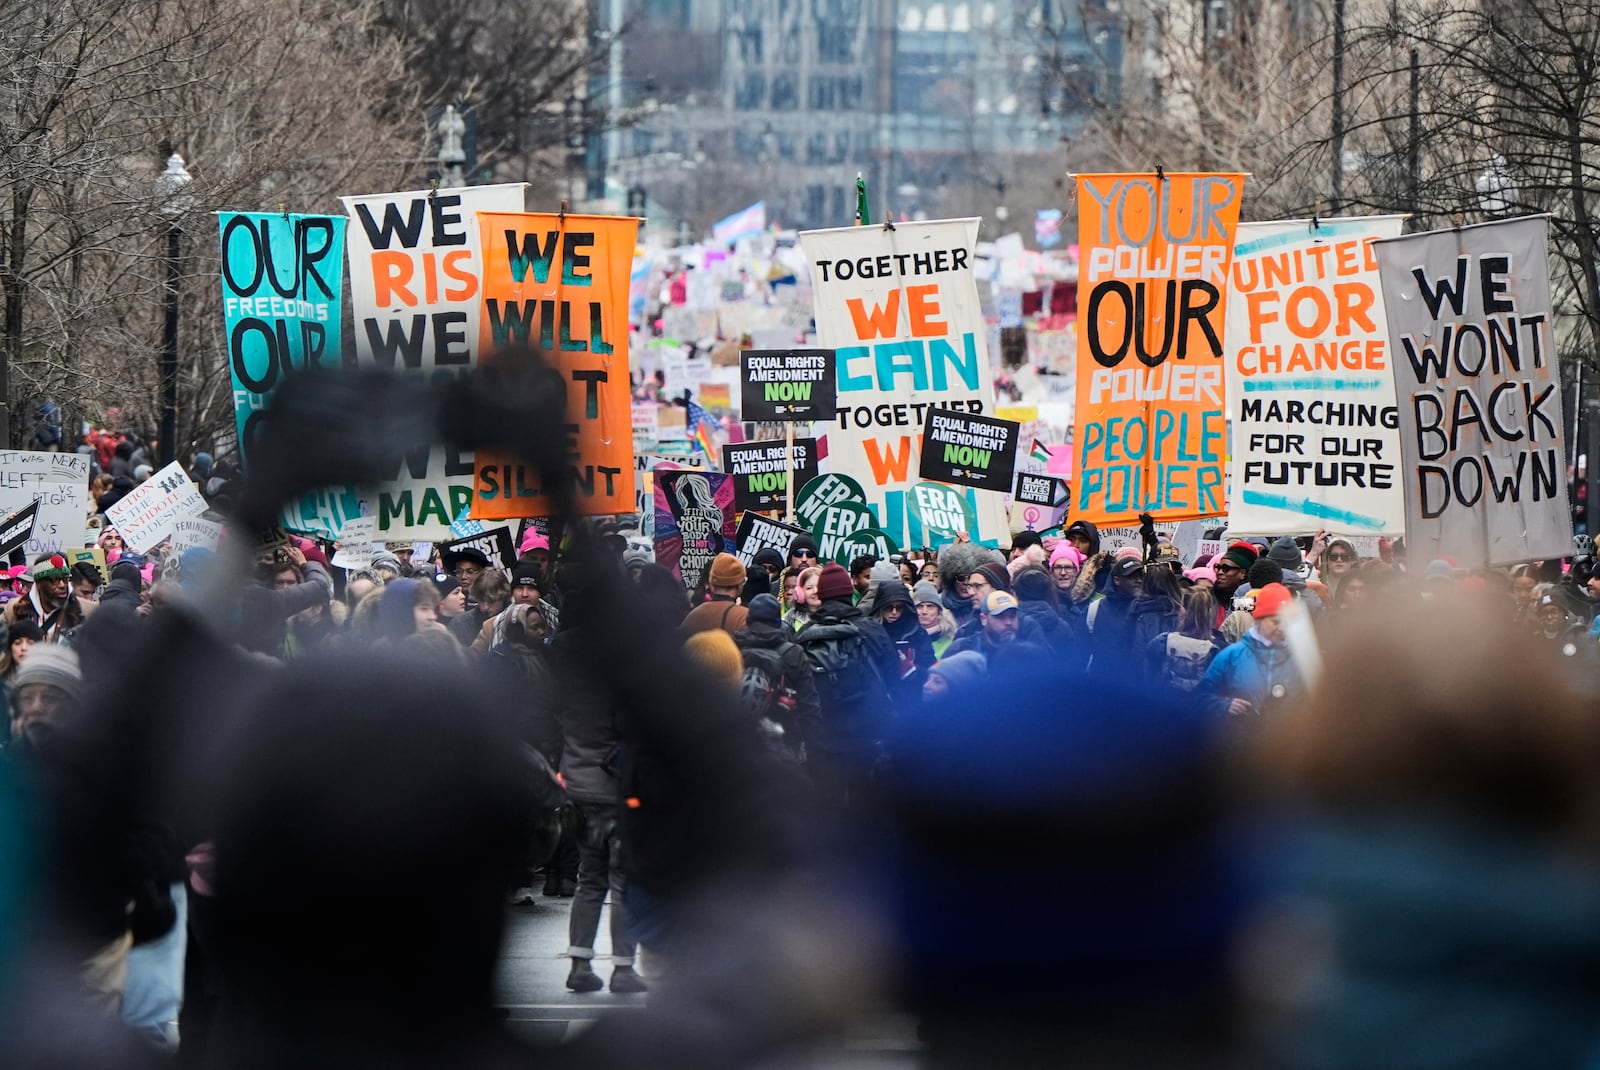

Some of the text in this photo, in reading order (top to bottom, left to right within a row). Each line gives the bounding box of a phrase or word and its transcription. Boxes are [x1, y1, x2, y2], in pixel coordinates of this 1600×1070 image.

[354, 195, 466, 249] WE
[1083, 176, 1236, 247] YOUR
[222, 214, 335, 300] OUR
[504, 229, 595, 286] WE
[816, 246, 969, 282] TOGETHER
[1088, 243, 1227, 283] POWER
[370, 249, 479, 308] RIS
[1410, 252, 1516, 321] WE
[486, 297, 614, 354] WILL
[846, 284, 948, 341] WE
[1086, 278, 1224, 369] OUR
[1246, 282, 1377, 345] FOR
[364, 311, 471, 369] WE
[1400, 312, 1548, 385] WONT
[747, 356, 826, 370] EQUAL RIGHTS
[836, 332, 980, 392] CAN
[1236, 339, 1386, 376] CHANGE
[749, 369, 825, 382] AMENDMENT
[764, 381, 812, 401] NOW
[1089, 363, 1223, 405] POWER
[932, 415, 968, 433] EQUAL
[968, 421, 1008, 440] RIGHTS
[1240, 399, 1399, 430] MARCHING
[1413, 380, 1559, 461] BACK
[931, 428, 1006, 452] AMENDMENT
[1082, 409, 1223, 465] PEOPLE
[1249, 433, 1384, 460] FOR OUR
[20, 455, 45, 463] WAS
[51, 453, 87, 474] NEVER
[730, 449, 766, 463] EQUAL
[766, 445, 807, 459] RIGTS
[733, 458, 807, 475] AMENDMNT
[943, 443, 993, 469] NOW
[0, 470, 48, 489] LEFT
[59, 484, 73, 496] VS
[479, 464, 621, 500] SILNT
[1022, 484, 1049, 495] LIVES
[1023, 476, 1051, 486] BLACK
[1079, 463, 1223, 513] POWER
[1244, 460, 1395, 489] FUTURE
[1418, 448, 1559, 520] DOWN
[111, 483, 155, 516] ACTION
[129, 496, 154, 518] THE
[914, 485, 963, 513] ERA
[1020, 490, 1049, 503] MATTER
[40, 522, 58, 534] VS
[123, 491, 182, 535] ANTIDOTE
[128, 528, 146, 546] TO
[147, 492, 202, 534] DESPAIR
[676, 520, 710, 532] YOUR
[680, 515, 704, 523] NOT
[823, 506, 870, 537] ERA
[919, 506, 966, 533] NOW
[175, 520, 218, 540] FEMINISTS
[681, 532, 709, 540] BODY
[750, 519, 799, 549] TRUST
